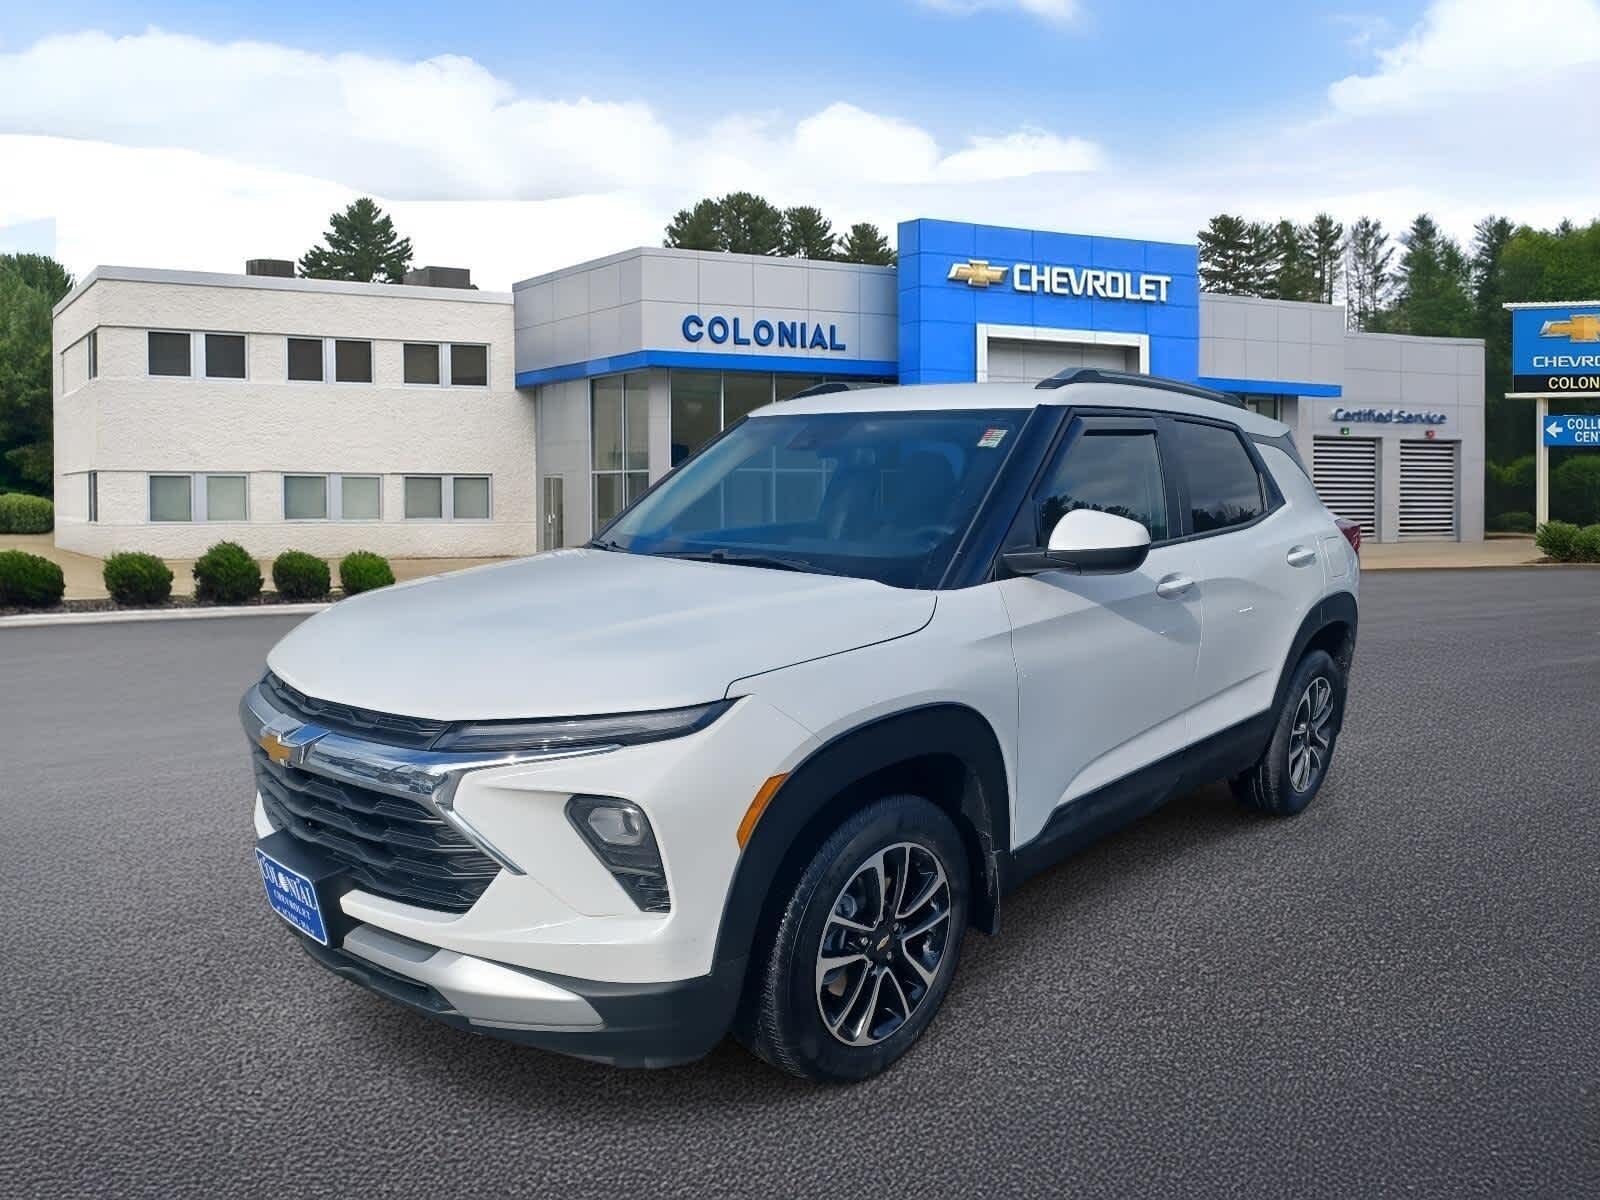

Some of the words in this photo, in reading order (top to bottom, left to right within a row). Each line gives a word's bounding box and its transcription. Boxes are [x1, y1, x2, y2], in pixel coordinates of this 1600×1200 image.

[1013, 263, 1171, 302] CHEVROLET
[682, 314, 847, 351] COLONIAL
[1548, 376, 1600, 389] COLON
[1331, 408, 1393, 423] Certified
[1394, 410, 1448, 424] Service
[1574, 431, 1600, 443] CEN
